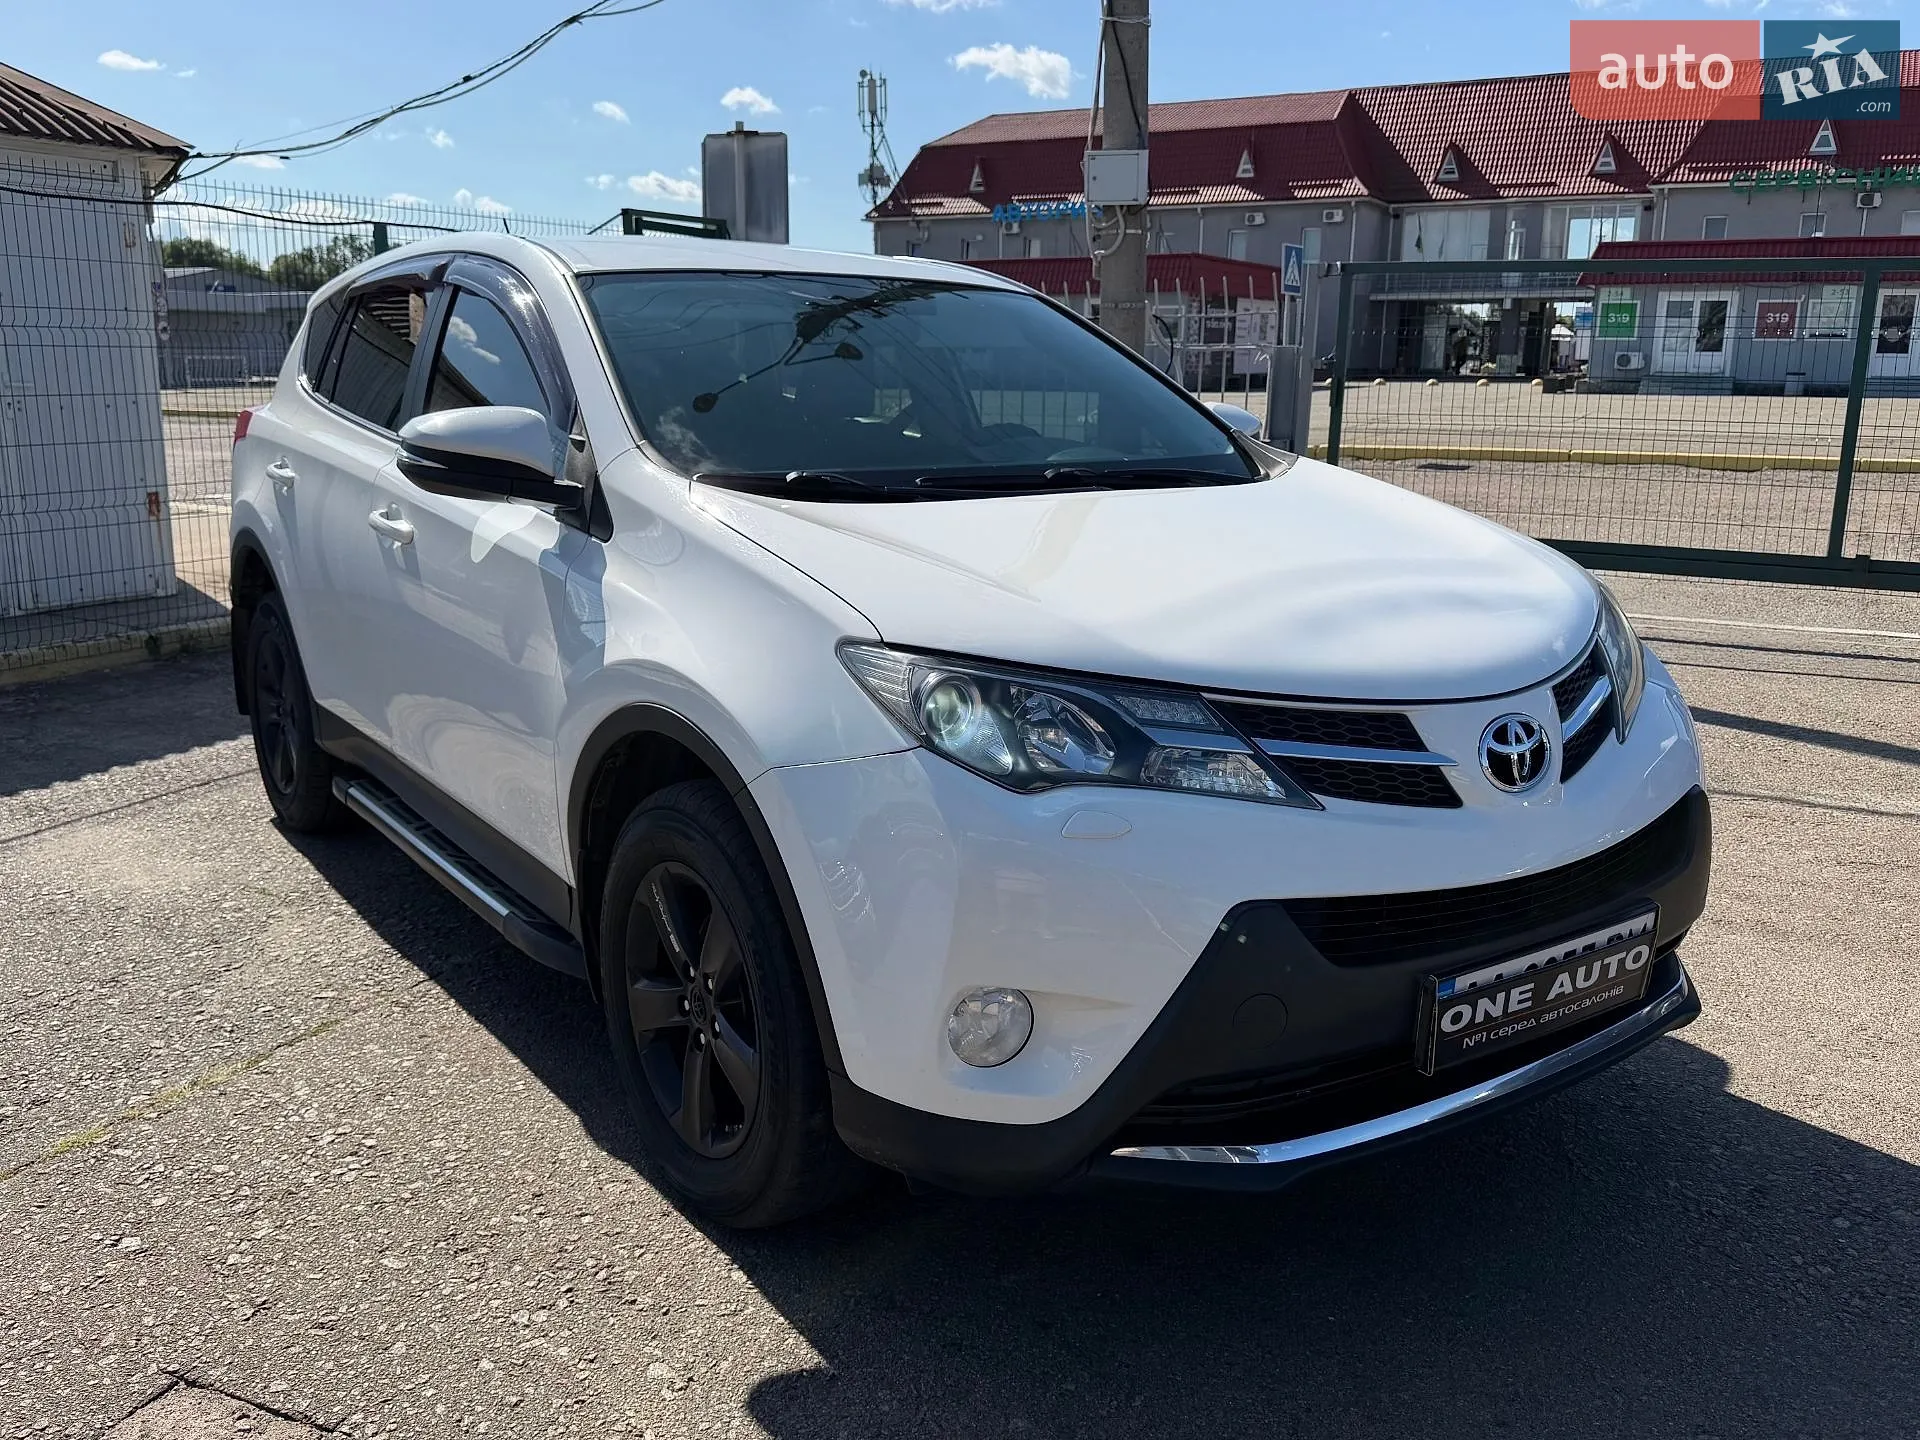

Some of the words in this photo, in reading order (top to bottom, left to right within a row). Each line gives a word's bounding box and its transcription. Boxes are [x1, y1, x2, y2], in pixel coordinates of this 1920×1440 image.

[1607, 313, 1630, 323] 319
[1766, 312, 1789, 323] 319
[1440, 982, 1535, 1033] ONE
[1545, 944, 1650, 1001] AUTO
[1490, 1018, 1537, 1039] серед
[1540, 984, 1624, 1024] автосалонів
